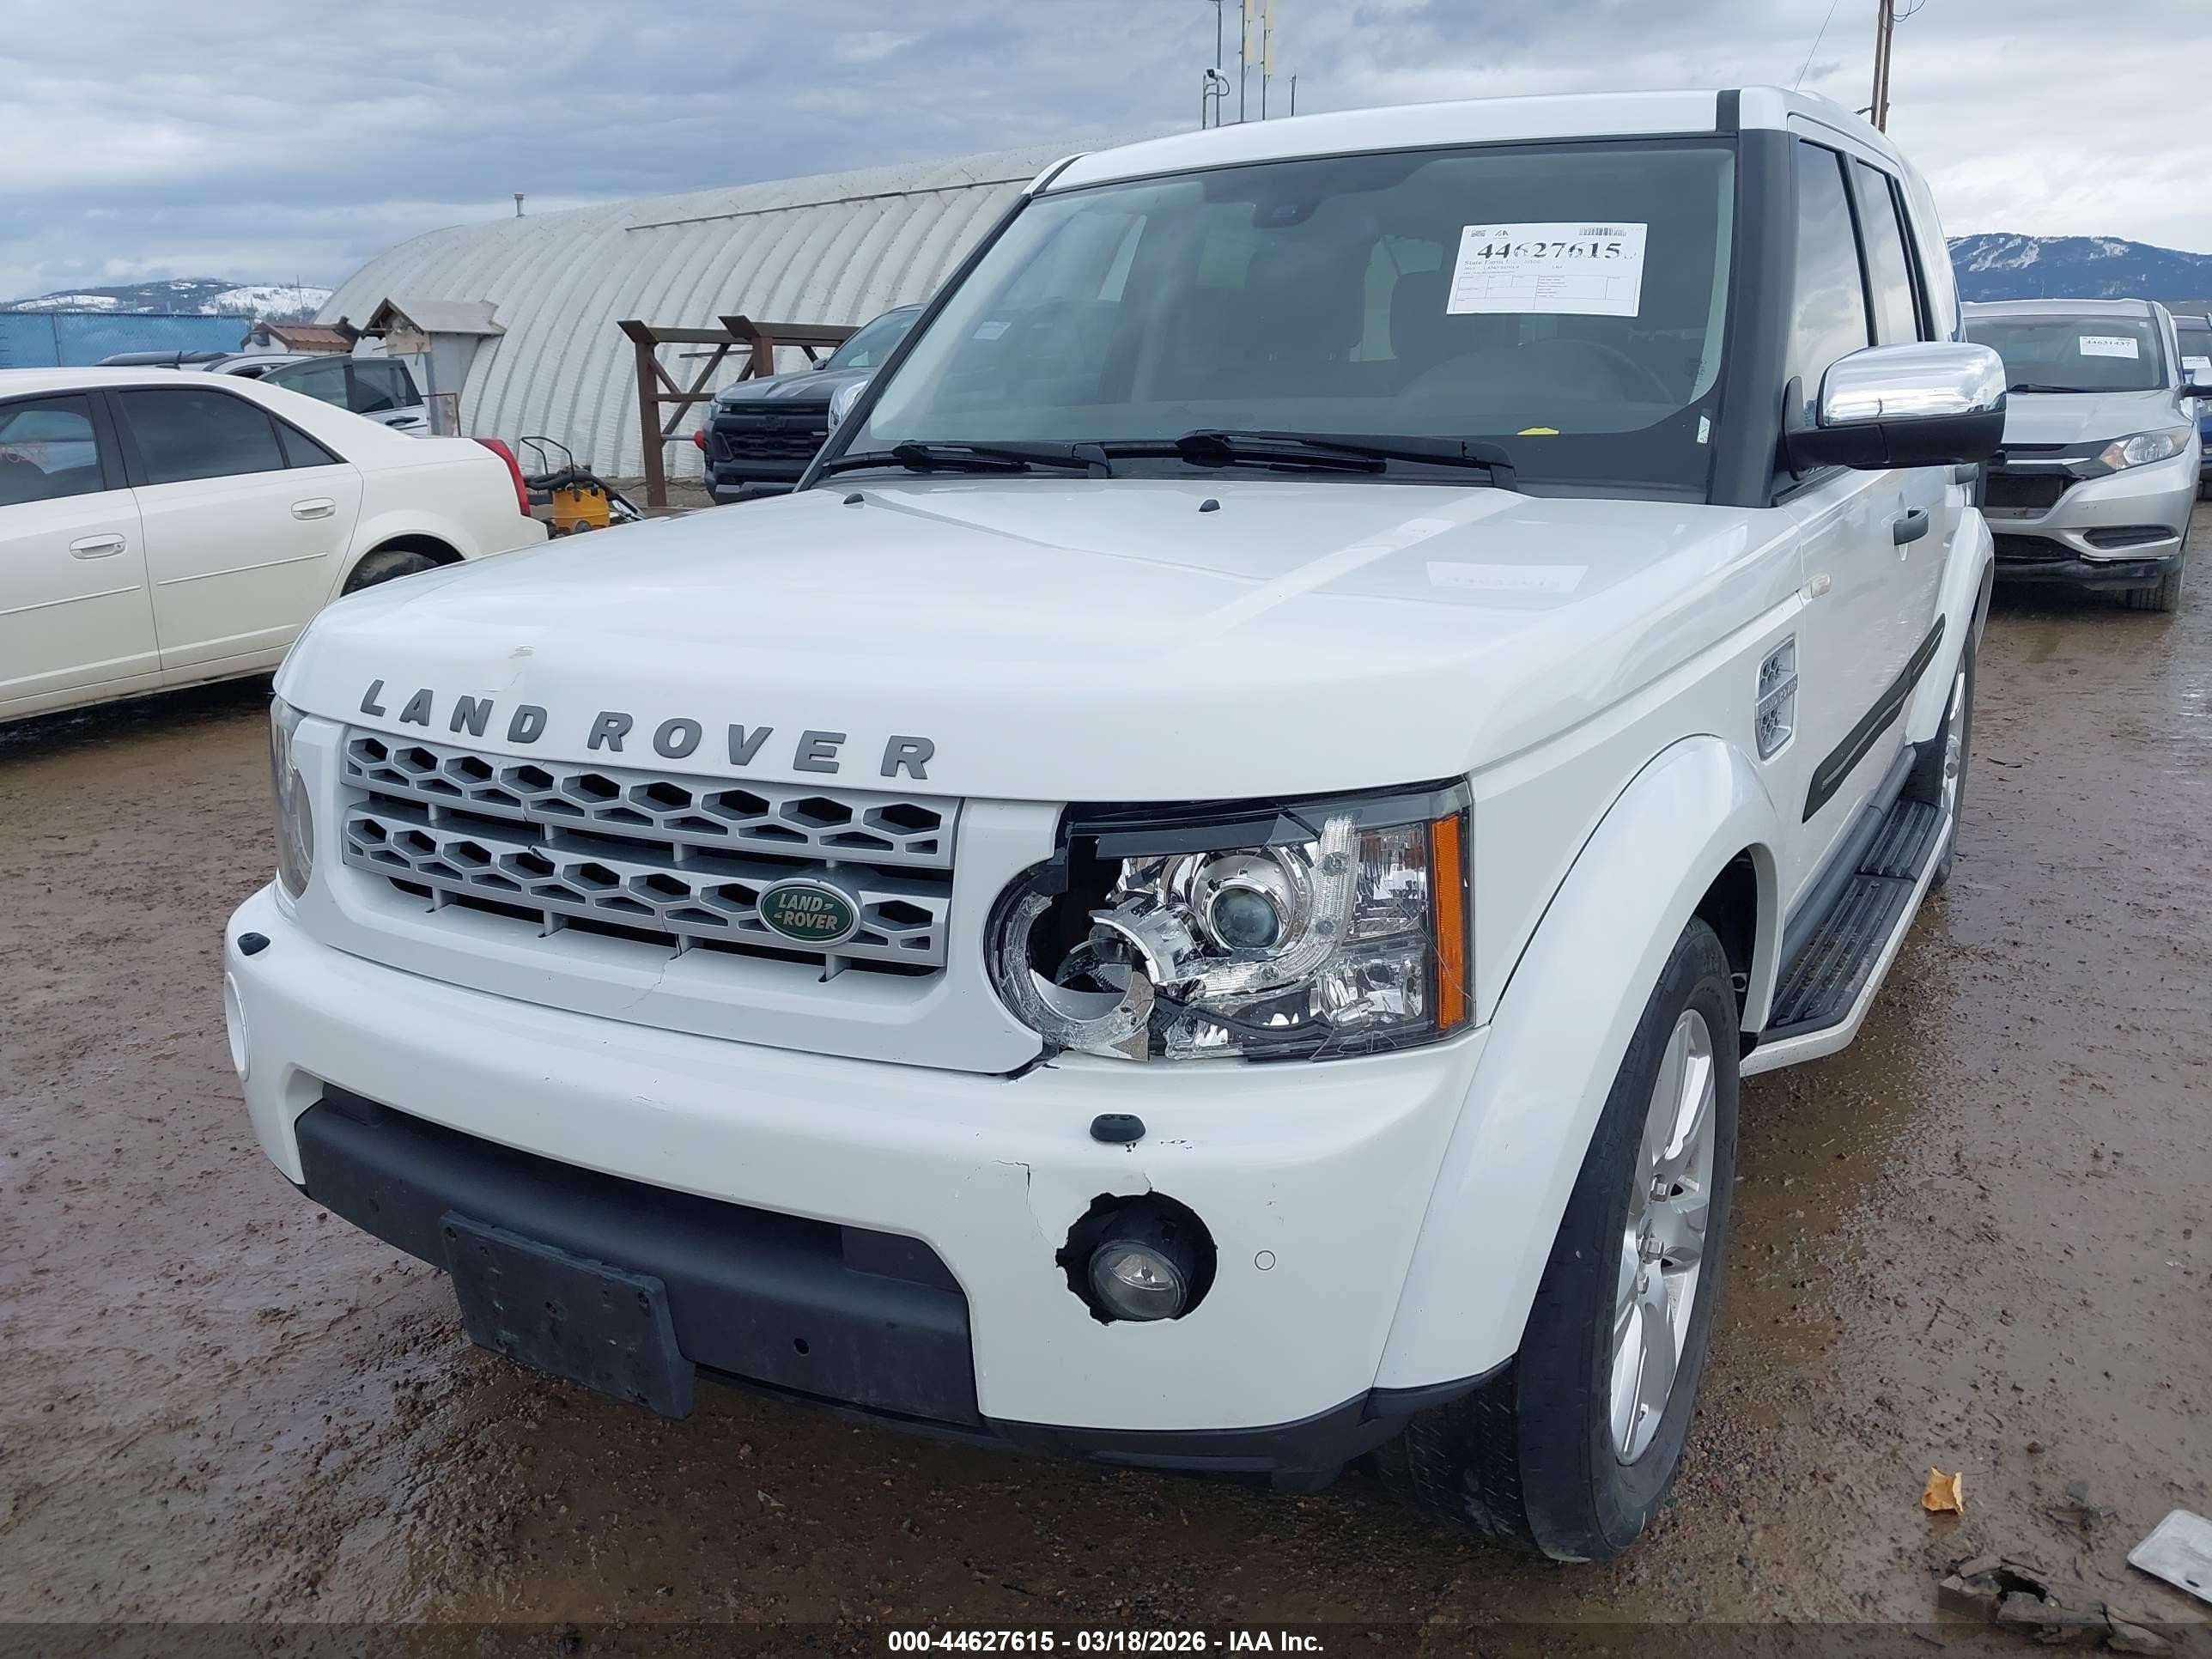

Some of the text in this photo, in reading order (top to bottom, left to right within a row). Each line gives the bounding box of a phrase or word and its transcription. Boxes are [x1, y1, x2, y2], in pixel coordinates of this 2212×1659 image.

[1477, 241, 1622, 259] 44627615
[359, 679, 936, 780] LAND ROVER
[778, 893, 823, 912] LAND
[782, 911, 838, 930] ROVER
